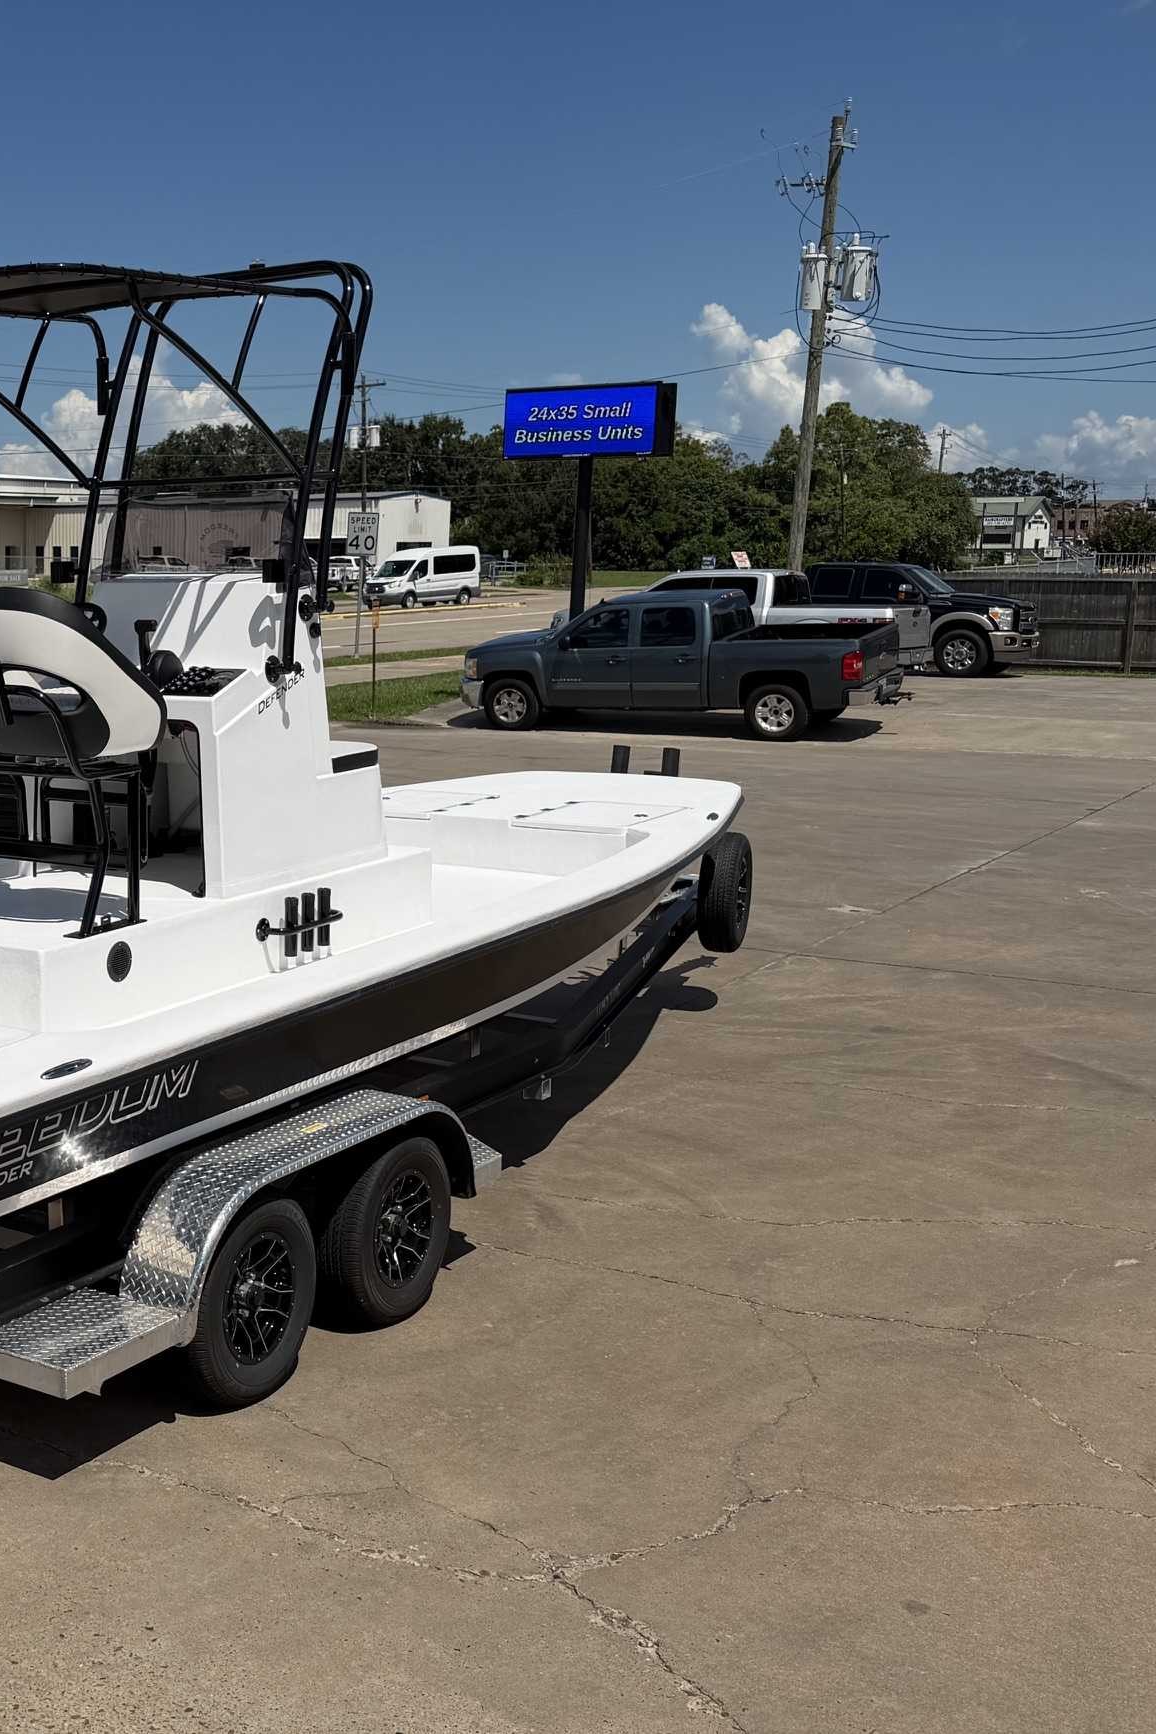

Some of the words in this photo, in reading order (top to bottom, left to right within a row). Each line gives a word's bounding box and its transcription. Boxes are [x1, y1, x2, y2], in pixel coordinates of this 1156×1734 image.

[528, 404, 578, 421] 24x35
[583, 402, 631, 419] Small
[515, 427, 592, 443] Business
[598, 424, 643, 440] Units
[350, 516, 377, 525] SPEED
[353, 525, 372, 534] LIMIT
[348, 535, 375, 550] 40
